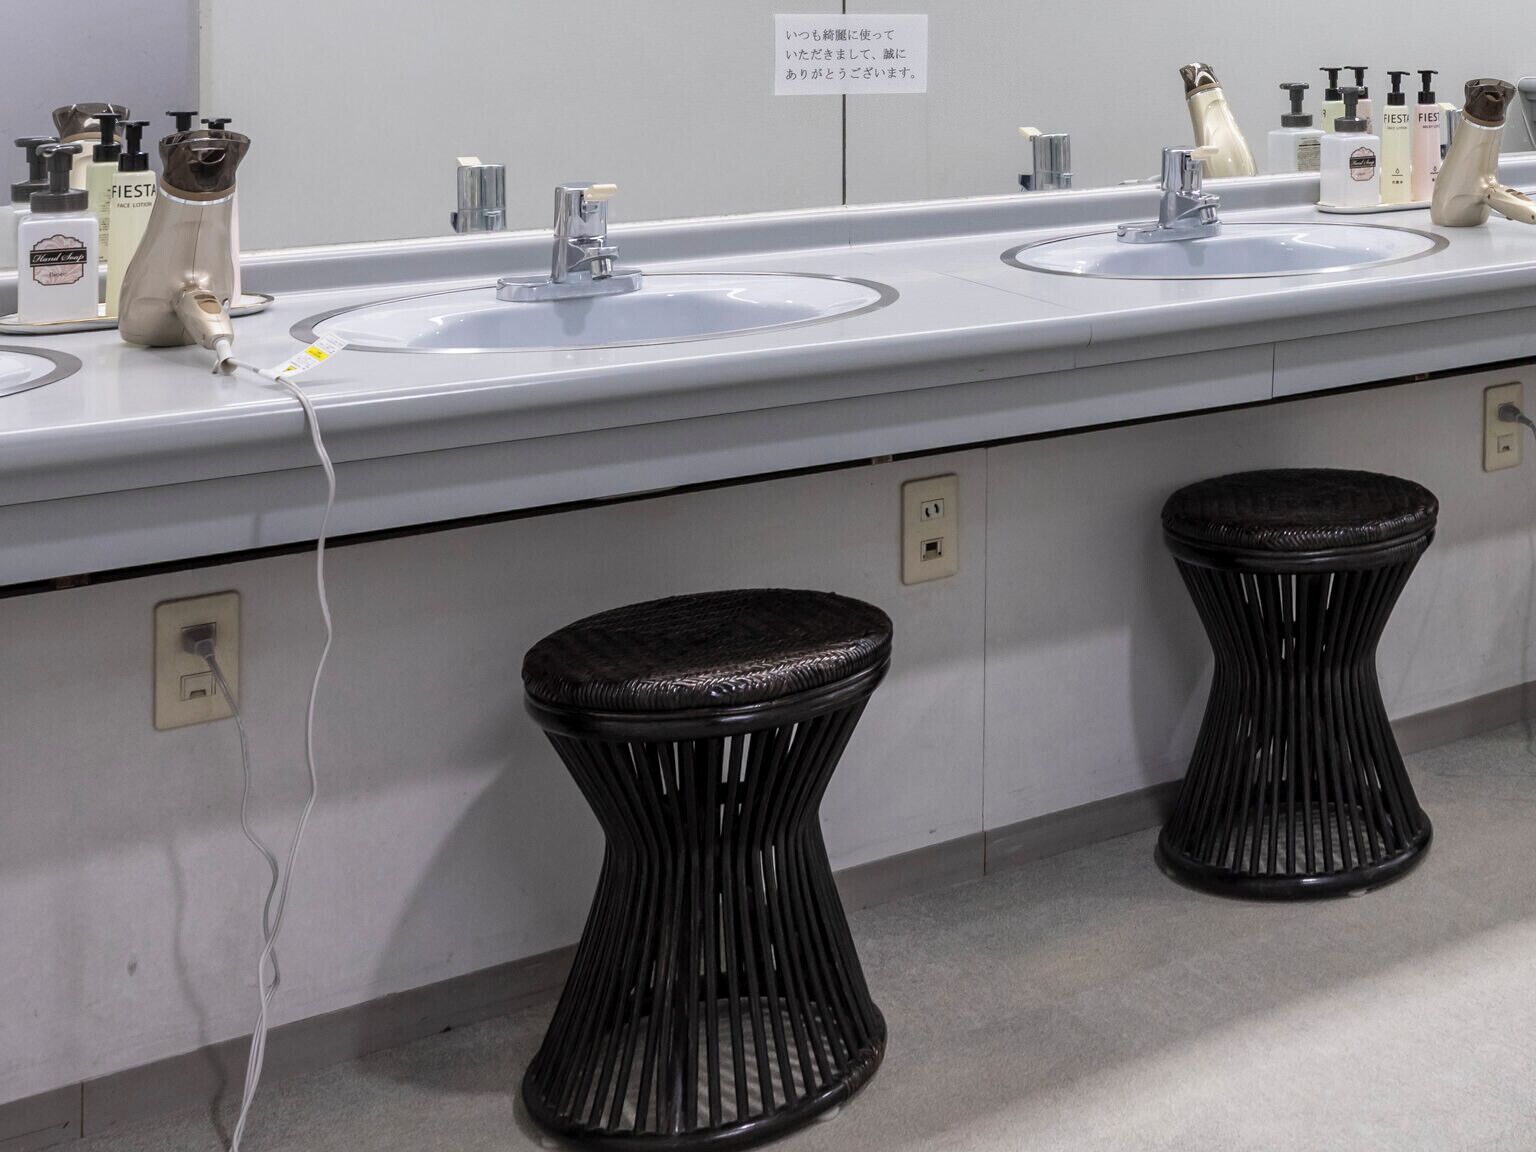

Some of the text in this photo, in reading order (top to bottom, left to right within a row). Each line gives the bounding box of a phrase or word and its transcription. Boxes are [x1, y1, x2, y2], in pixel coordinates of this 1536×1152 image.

[785, 29, 895, 41] いつも綺麗に使って
[786, 47, 906, 61] いただきまして、誠に
[785, 67, 917, 80] ありがとうございます。
[32, 252, 85, 263] Hand Soap
